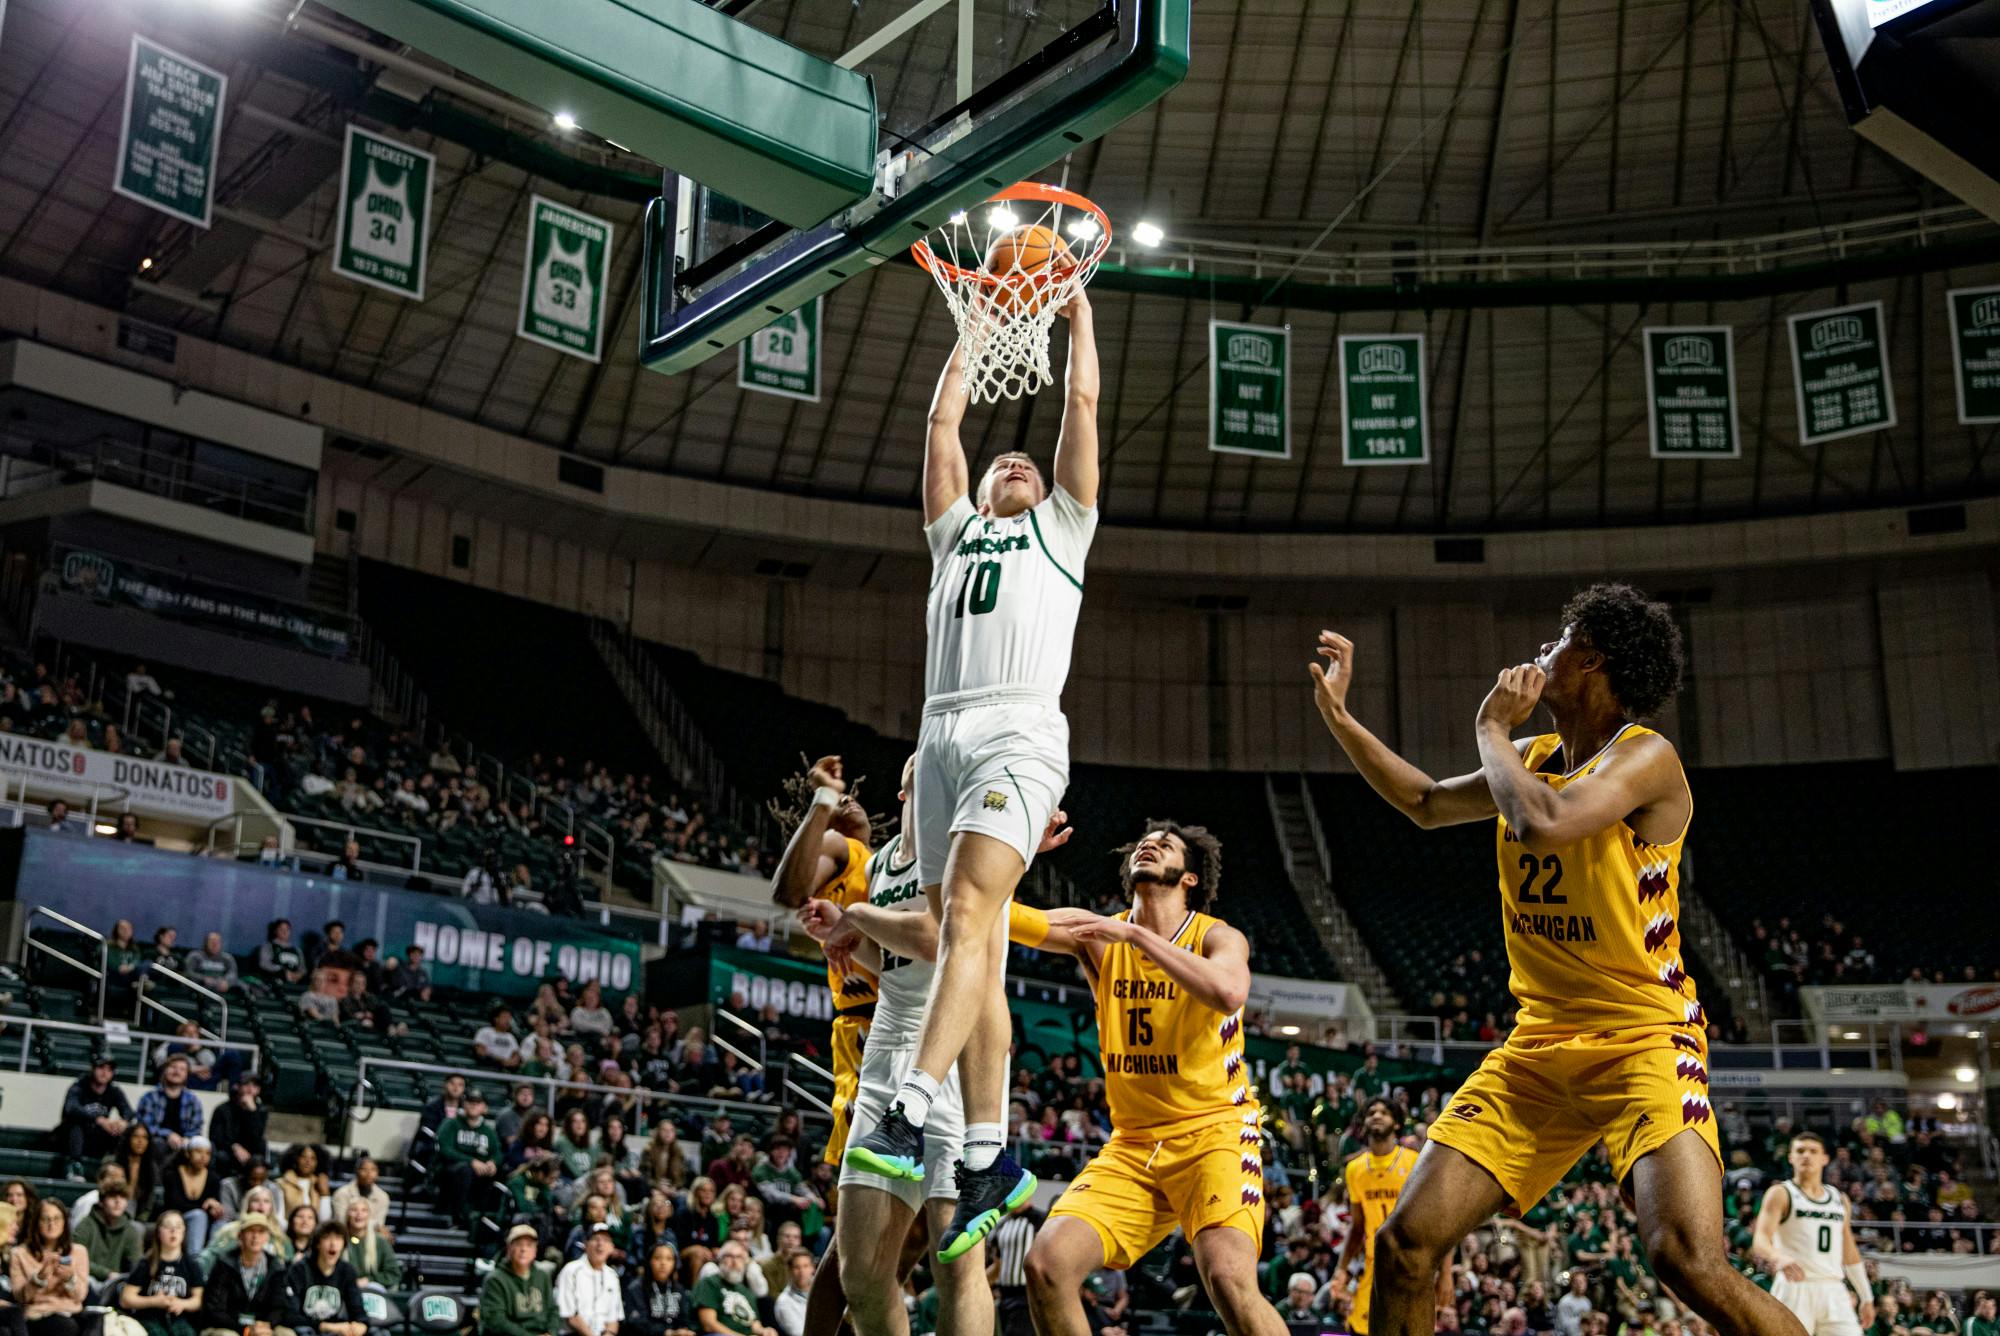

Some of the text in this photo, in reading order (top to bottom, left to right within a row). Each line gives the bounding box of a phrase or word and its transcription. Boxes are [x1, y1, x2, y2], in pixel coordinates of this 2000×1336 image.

[364, 139, 416, 172] LUCKETT
[367, 193, 403, 223] OHIO
[369, 219, 397, 246] 34
[551, 284, 576, 310] 33
[769, 332, 792, 356] 20
[1810, 315, 1864, 352] OHIO
[1228, 333, 1274, 368] OHIO
[1358, 343, 1406, 376] OHIO
[1664, 335, 1715, 368] OHIO
[1238, 383, 1264, 401] NIT
[1370, 394, 1397, 411] NIT
[1352, 416, 1418, 432] RUNNER-UP
[1365, 437, 1407, 455] 1941
[955, 560, 1002, 618] 10
[180, 592, 216, 615] FANS
[215, 601, 233, 616] IN
[232, 605, 258, 623] THE
[258, 611, 287, 630] MAC
[316, 625, 349, 644] HERE
[113, 757, 214, 801] DONATOS
[1518, 853, 1567, 905] 22
[413, 920, 632, 991] HOME OF OHIO
[1113, 979, 1175, 1000] CENTRAL
[1127, 1007, 1153, 1046] 15
[1107, 1053, 1178, 1074] MICHIGAN
[1818, 1226, 1830, 1252] 0
